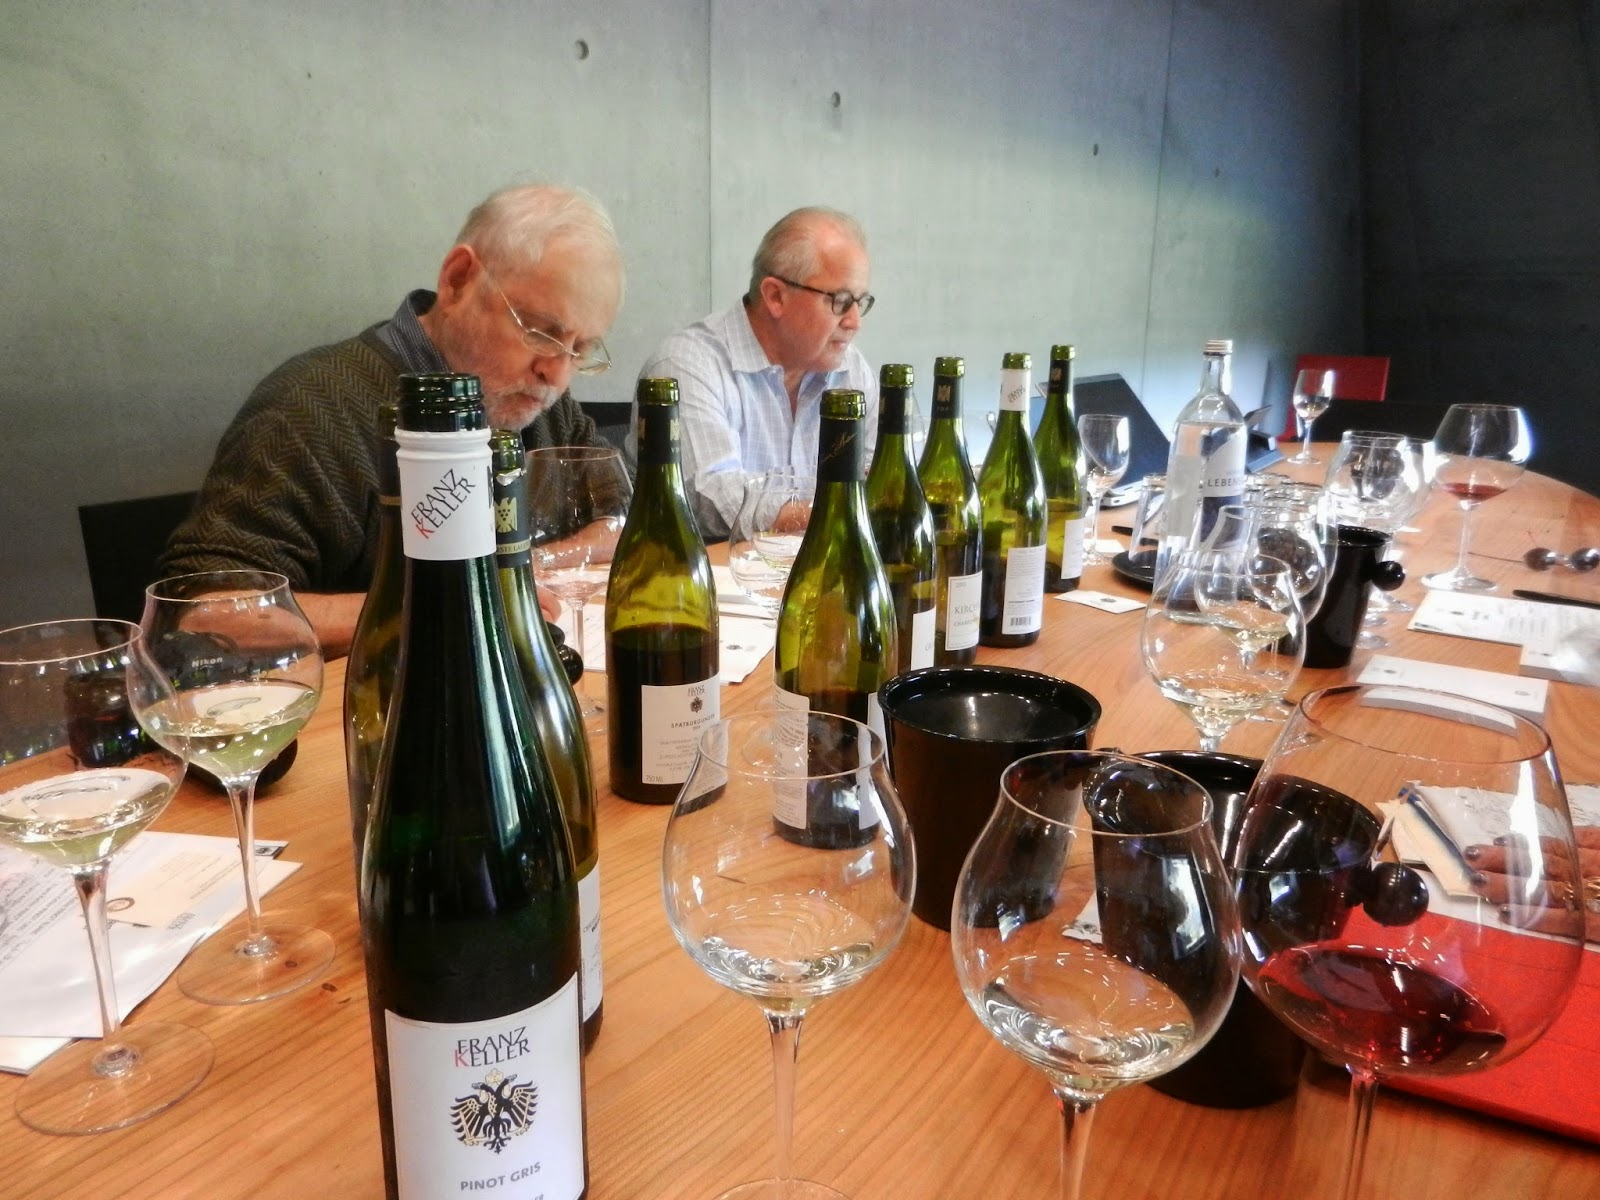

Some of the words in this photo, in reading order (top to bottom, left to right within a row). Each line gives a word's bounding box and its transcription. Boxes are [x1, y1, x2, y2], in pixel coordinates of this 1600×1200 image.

[410, 468, 459, 525] FRANZ
[415, 477, 476, 540] KELLER
[191, 657, 223, 668] Nikon
[454, 1038, 531, 1067] KELLER
[456, 1026, 528, 1054] FRANZ
[460, 1176, 506, 1191] PINOT
[510, 1162, 541, 1182] GRIS
